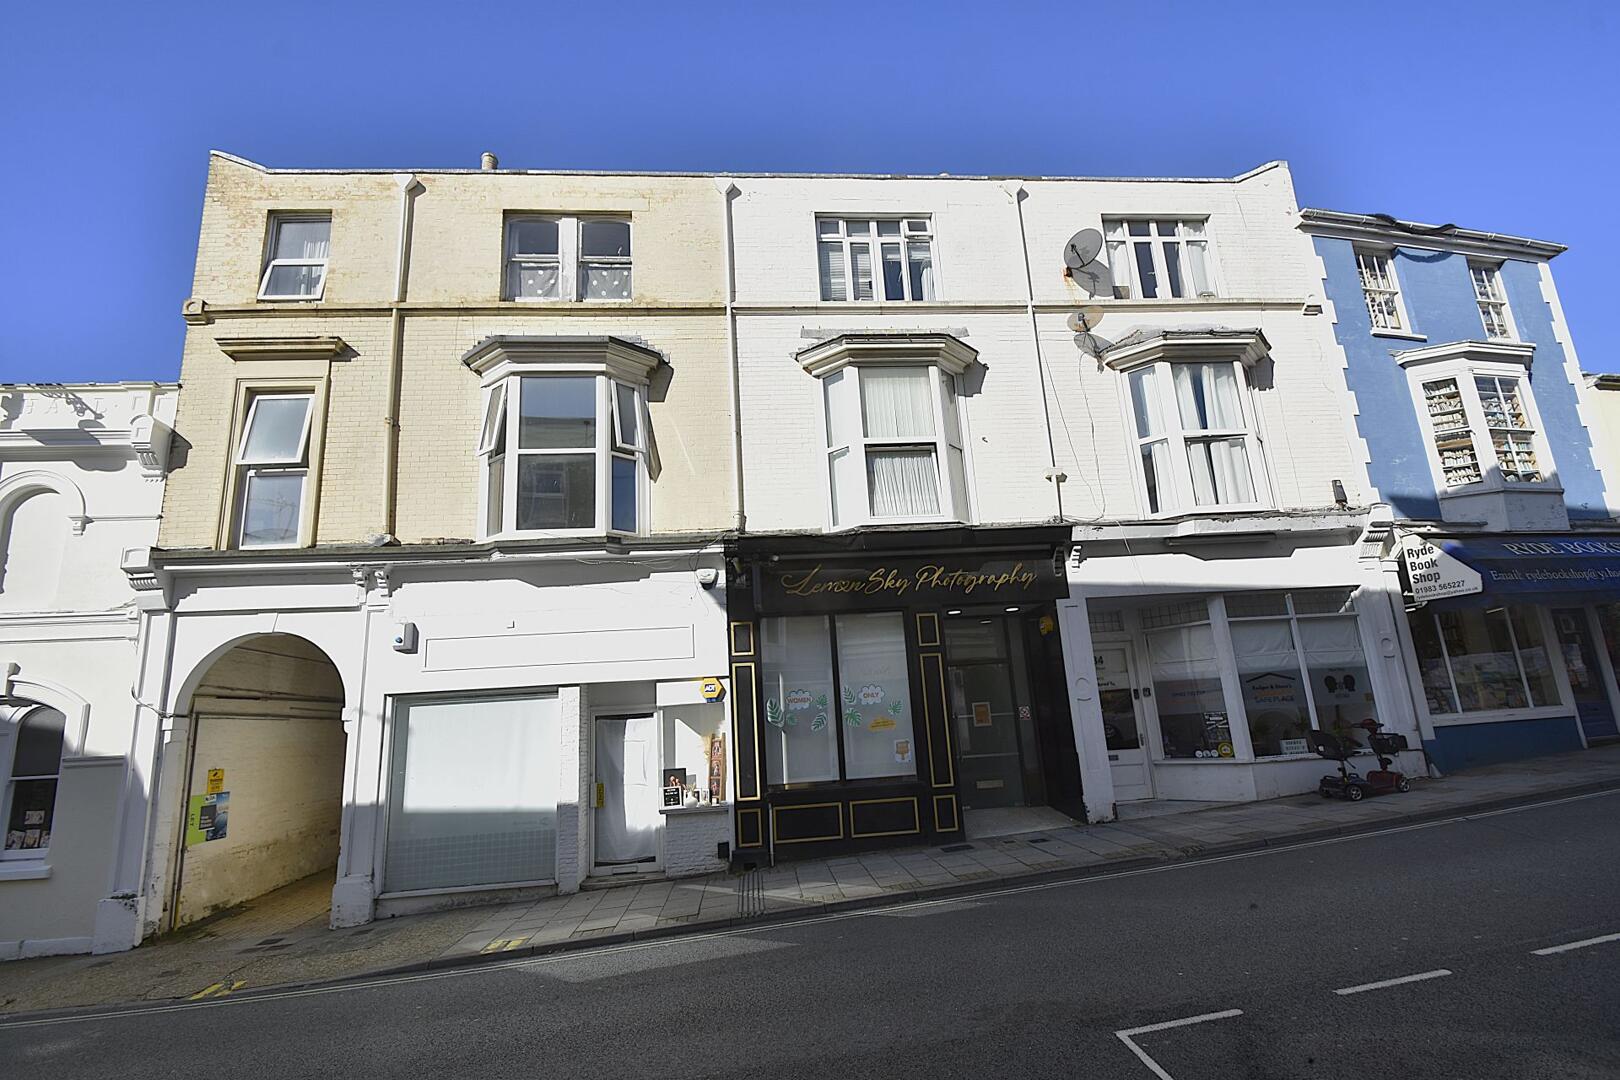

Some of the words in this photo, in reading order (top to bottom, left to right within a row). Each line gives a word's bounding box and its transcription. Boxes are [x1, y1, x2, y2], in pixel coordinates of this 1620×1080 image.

[1407, 545, 1434, 559] Ryde
[1503, 542, 1565, 555] RYDE
[1410, 558, 1439, 571] Book
[780, 564, 866, 596] Lemon
[864, 568, 911, 595] Sky
[915, 562, 1037, 595] Photography
[1412, 572, 1441, 584] Shop
[1415, 585, 1437, 594] 01983
[1439, 580, 1465, 590] 565227
[863, 691, 880, 699] ONLY
